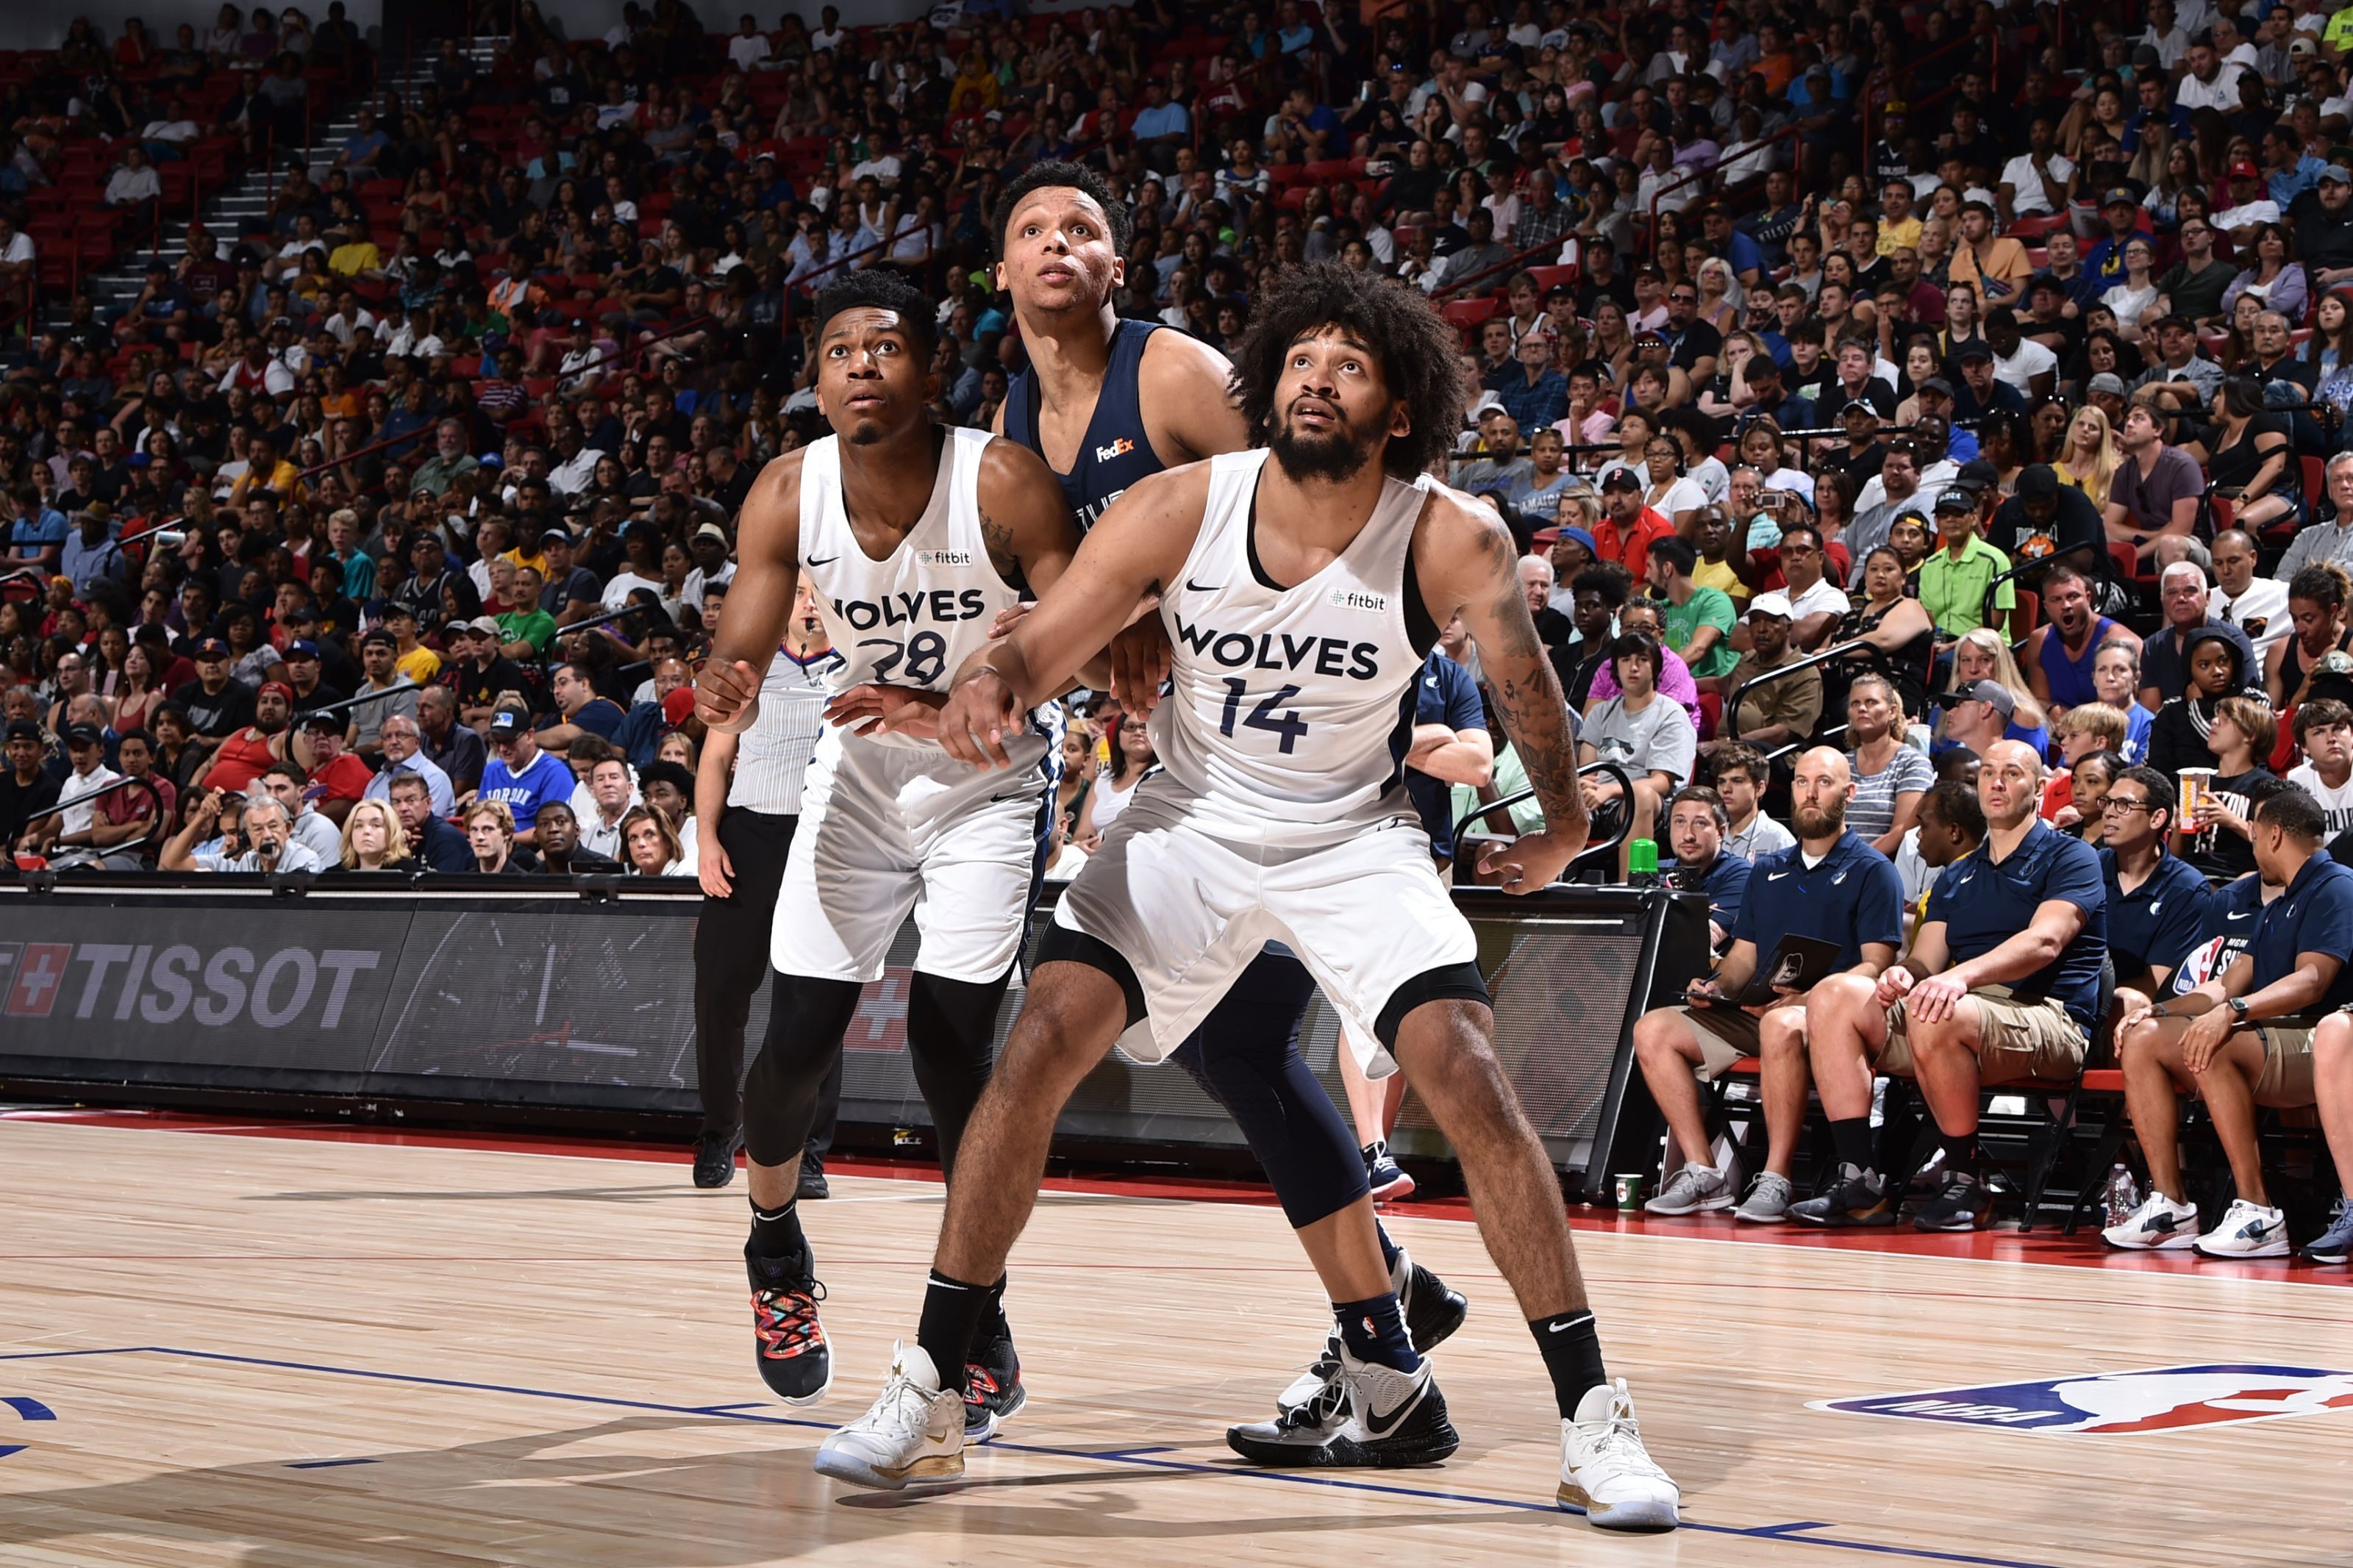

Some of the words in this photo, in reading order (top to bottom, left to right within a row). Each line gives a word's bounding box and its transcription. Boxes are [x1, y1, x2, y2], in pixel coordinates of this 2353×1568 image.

[1096, 438, 1135, 463] FedEx
[935, 551, 970, 564] fitbit
[1348, 593, 1385, 610] fitbit
[1174, 612, 1379, 680] WOLVES
[1220, 677, 1309, 755] 14
[2227, 937, 2249, 948] MGM
[75, 943, 382, 1029] TISSOT
[2177, 978, 2194, 992] NBA
[1861, 1399, 2065, 1423] NBA
